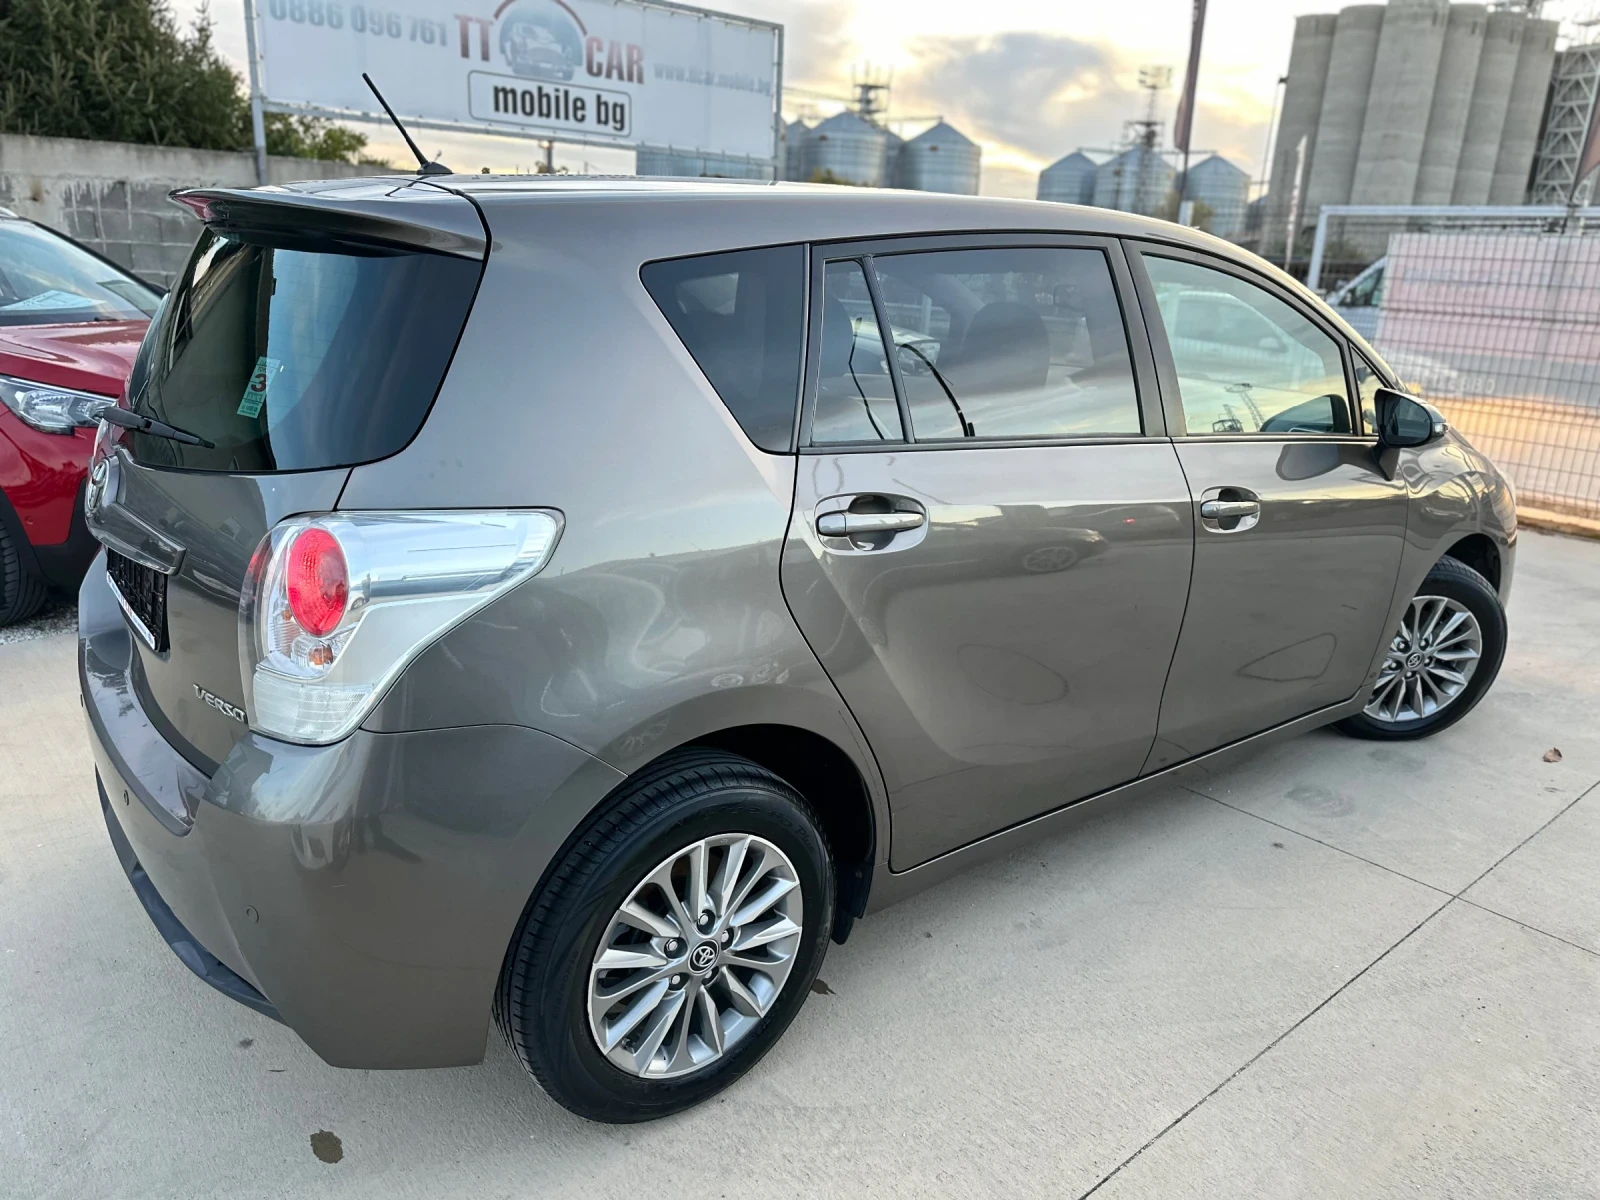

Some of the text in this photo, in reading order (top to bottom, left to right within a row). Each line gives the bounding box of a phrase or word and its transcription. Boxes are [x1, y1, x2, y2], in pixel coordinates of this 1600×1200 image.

[269, 0, 447, 47] 0886 096 761
[454, 14, 645, 85] TT CAR
[493, 85, 626, 132] mobile bg
[251, 373, 268, 393] 3
[192, 683, 247, 723] VERSO
